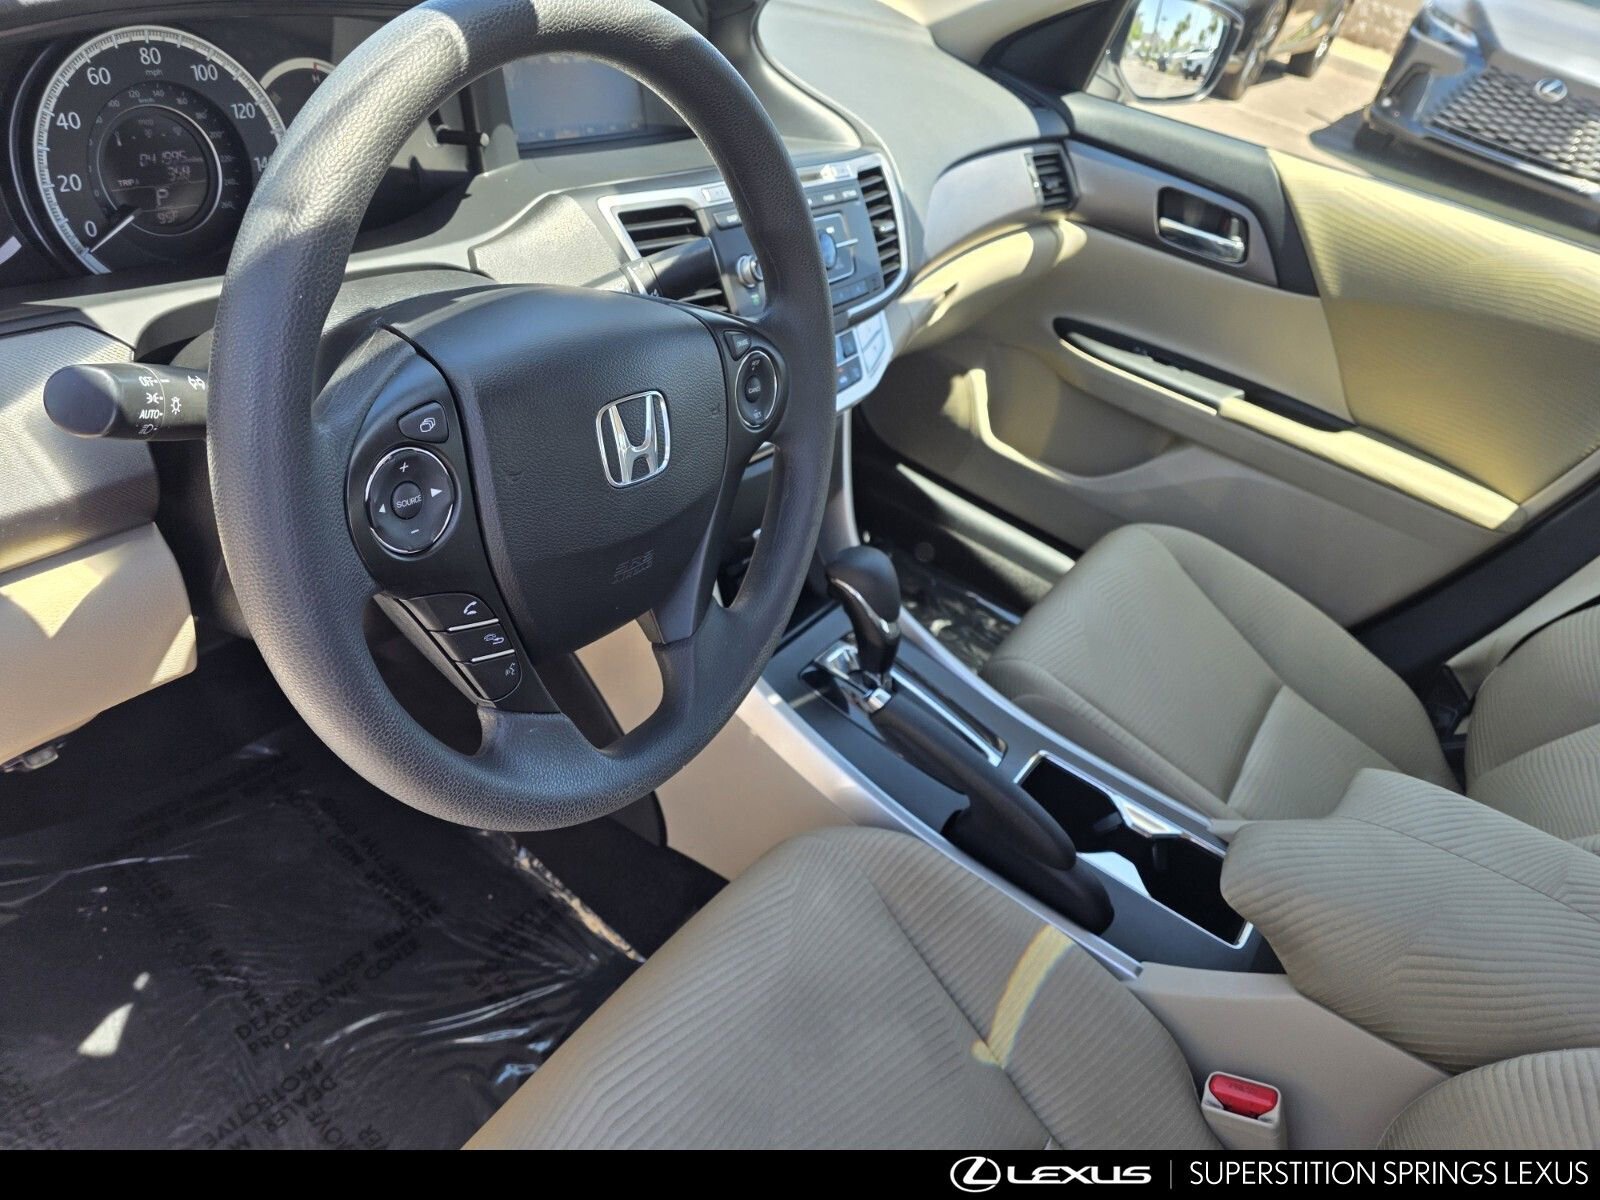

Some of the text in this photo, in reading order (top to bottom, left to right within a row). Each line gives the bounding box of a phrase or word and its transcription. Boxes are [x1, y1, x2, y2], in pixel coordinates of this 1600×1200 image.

[139, 47, 162, 65] 80
[86, 67, 111, 86] 60
[190, 63, 219, 82] 100
[230, 102, 256, 119] 120
[56, 112, 81, 130] 40
[253, 156, 269, 173] 14
[57, 174, 82, 193] 20
[117, 178, 134, 187] TRIP
[156, 188, 169, 206] P
[84, 220, 98, 238] 0
[138, 409, 160, 419] AUTO
[396, 494, 423, 509] SOURCE
